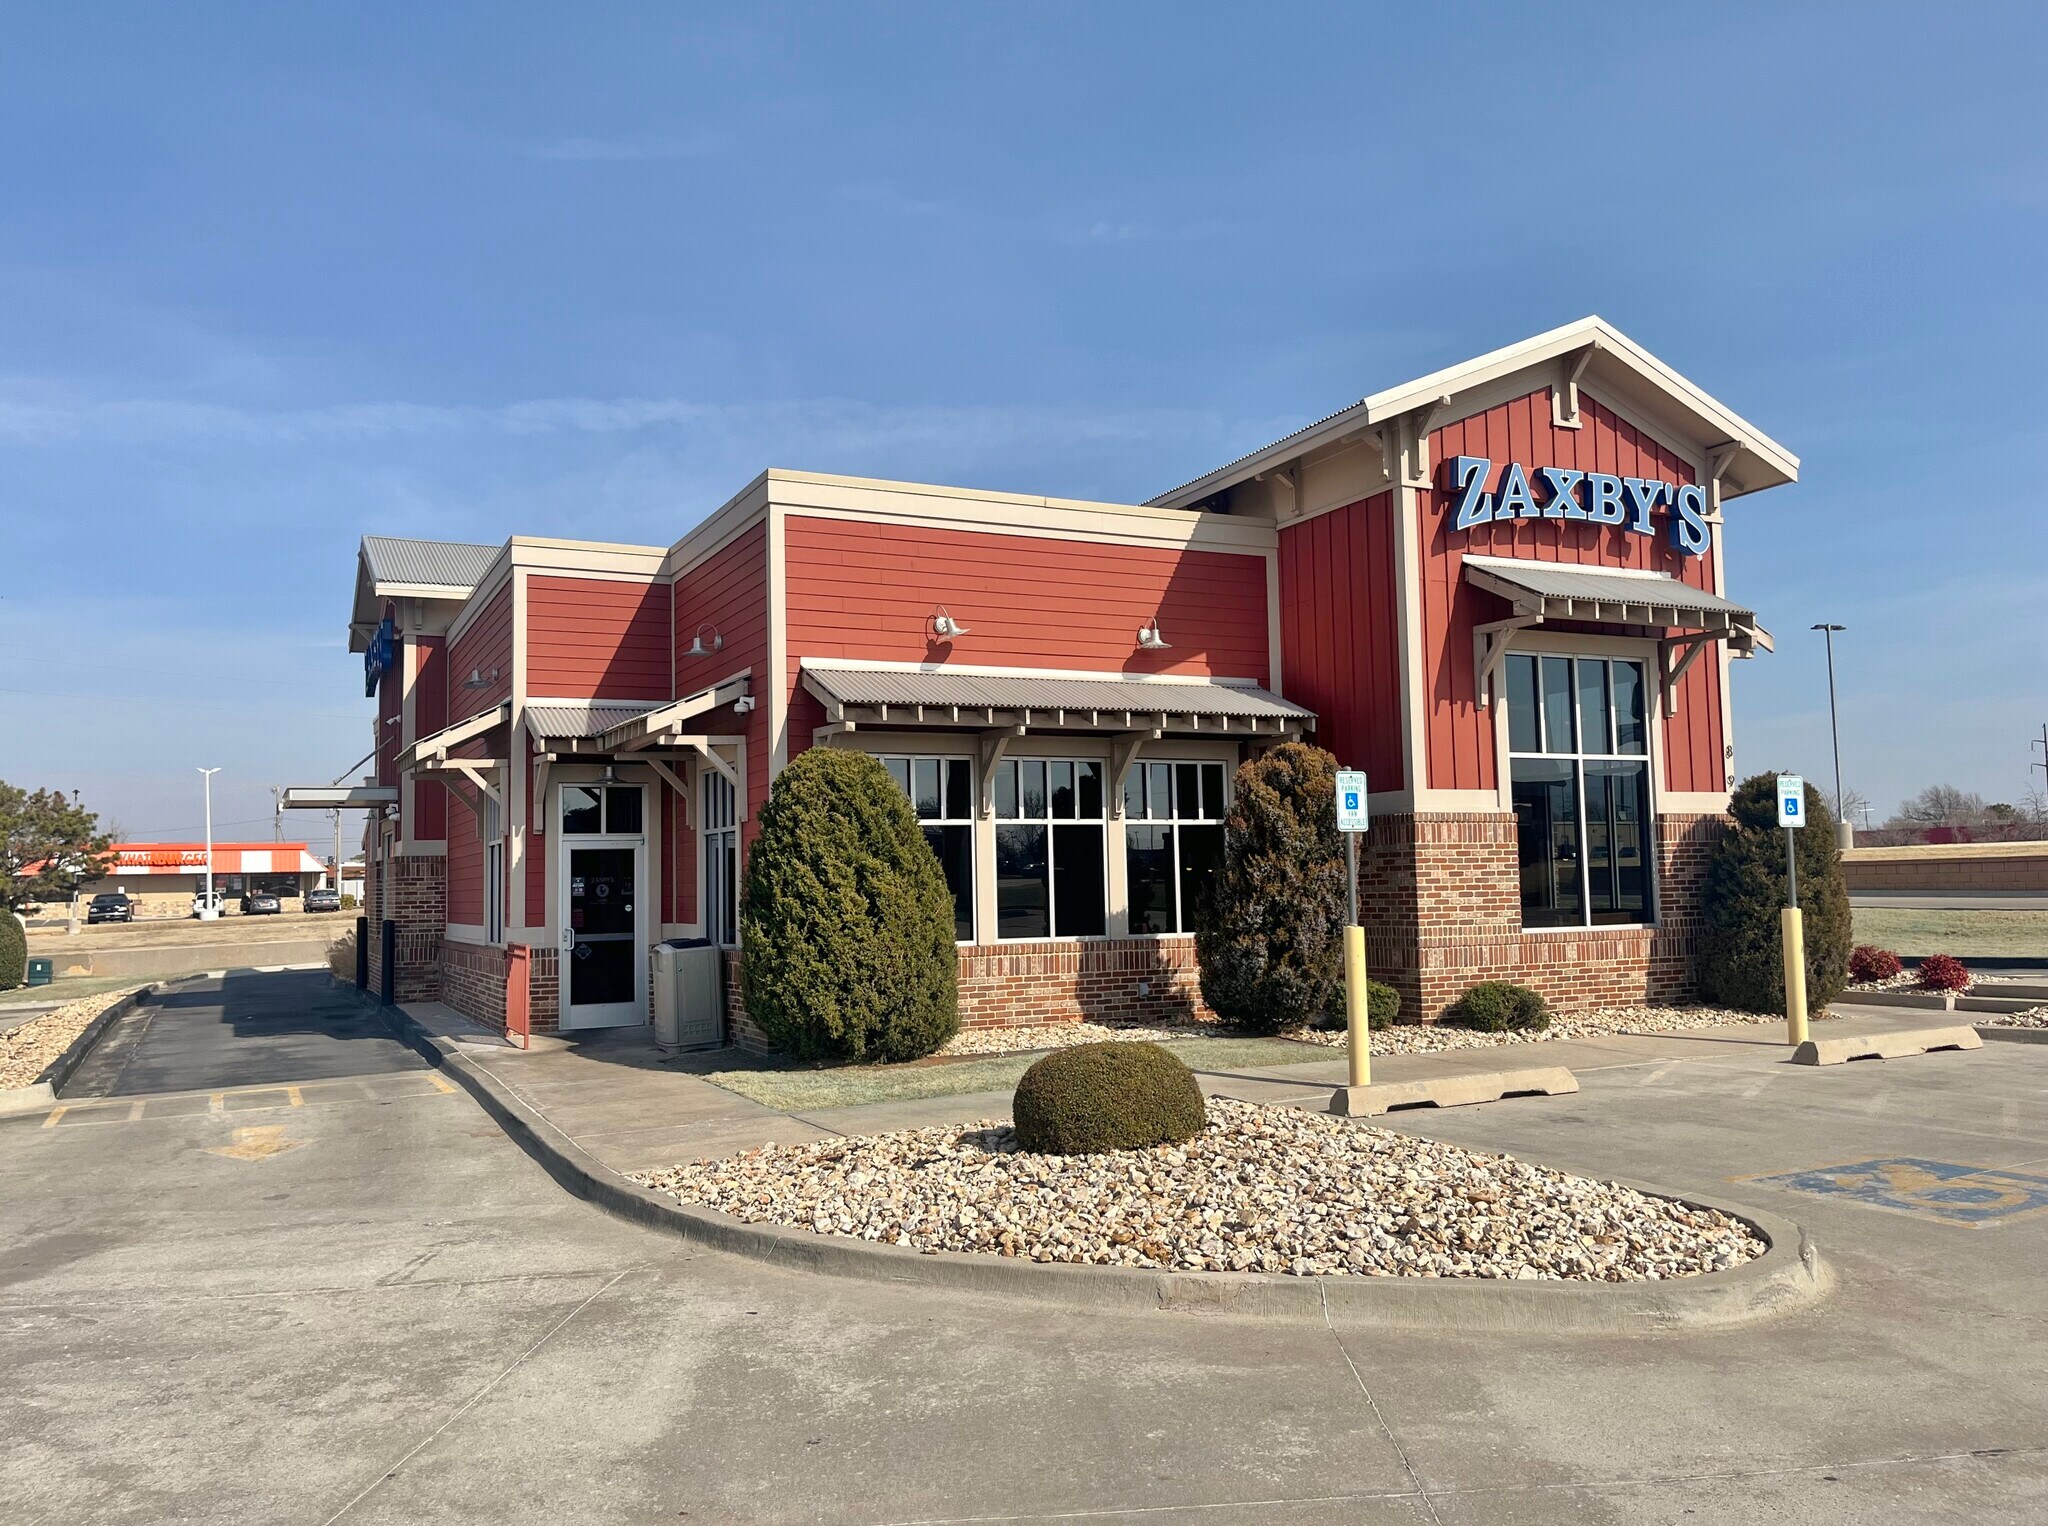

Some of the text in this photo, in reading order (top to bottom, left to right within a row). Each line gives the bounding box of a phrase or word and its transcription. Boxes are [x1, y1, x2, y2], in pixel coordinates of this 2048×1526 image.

[1451, 455, 1711, 556] ZAXBY'S
[1339, 776, 1363, 784] RESERVED
[1340, 818, 1365, 826] ACCESSIBLE
